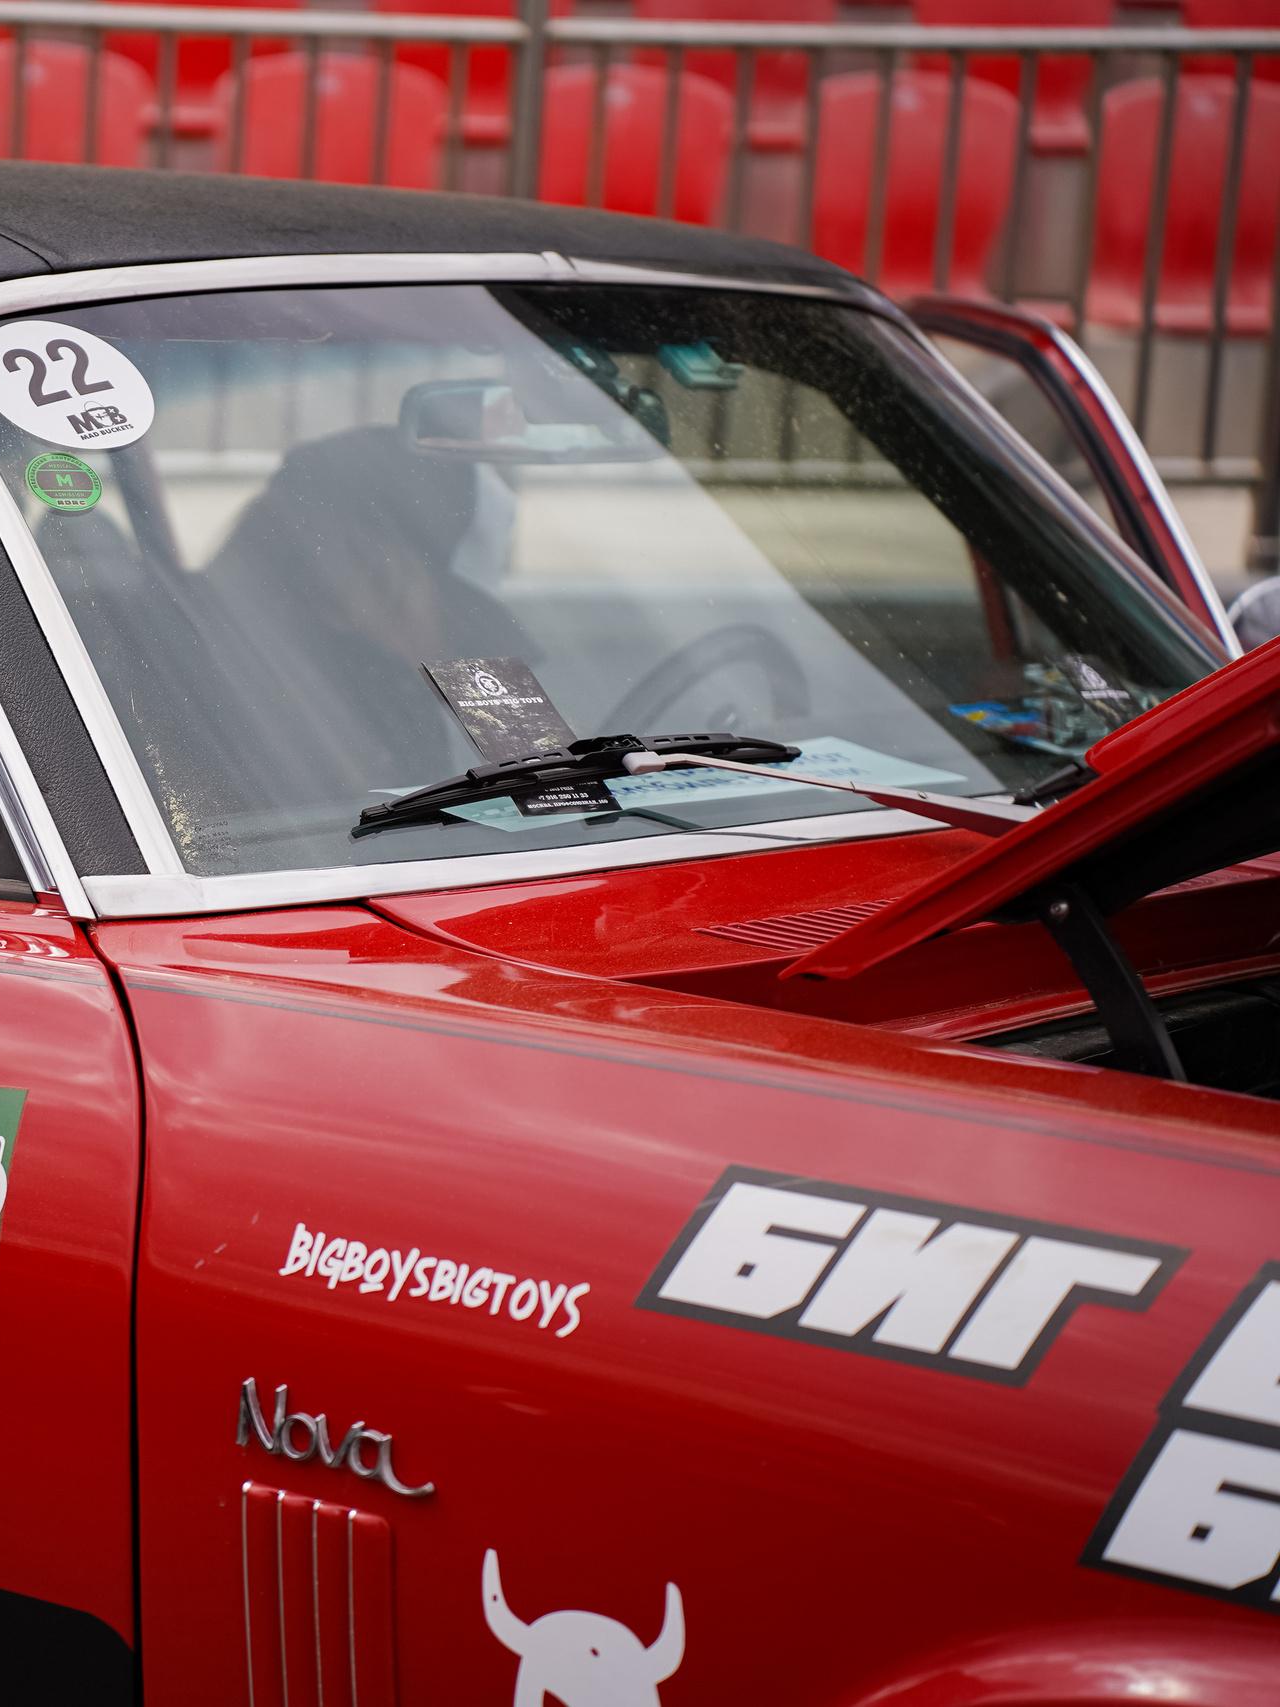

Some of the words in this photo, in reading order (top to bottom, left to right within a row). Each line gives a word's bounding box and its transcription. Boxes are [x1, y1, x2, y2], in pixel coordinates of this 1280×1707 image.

[3, 339, 114, 407] 22
[80, 432, 100, 441] MAD
[100, 423, 134, 436] BUCKETS
[56, 473, 74, 487] M
[279, 1222, 591, 1338] BIGBOYSBIGTOYS
[657, 1181, 1163, 1370] БИГ
[236, 1377, 435, 1495] Nova
